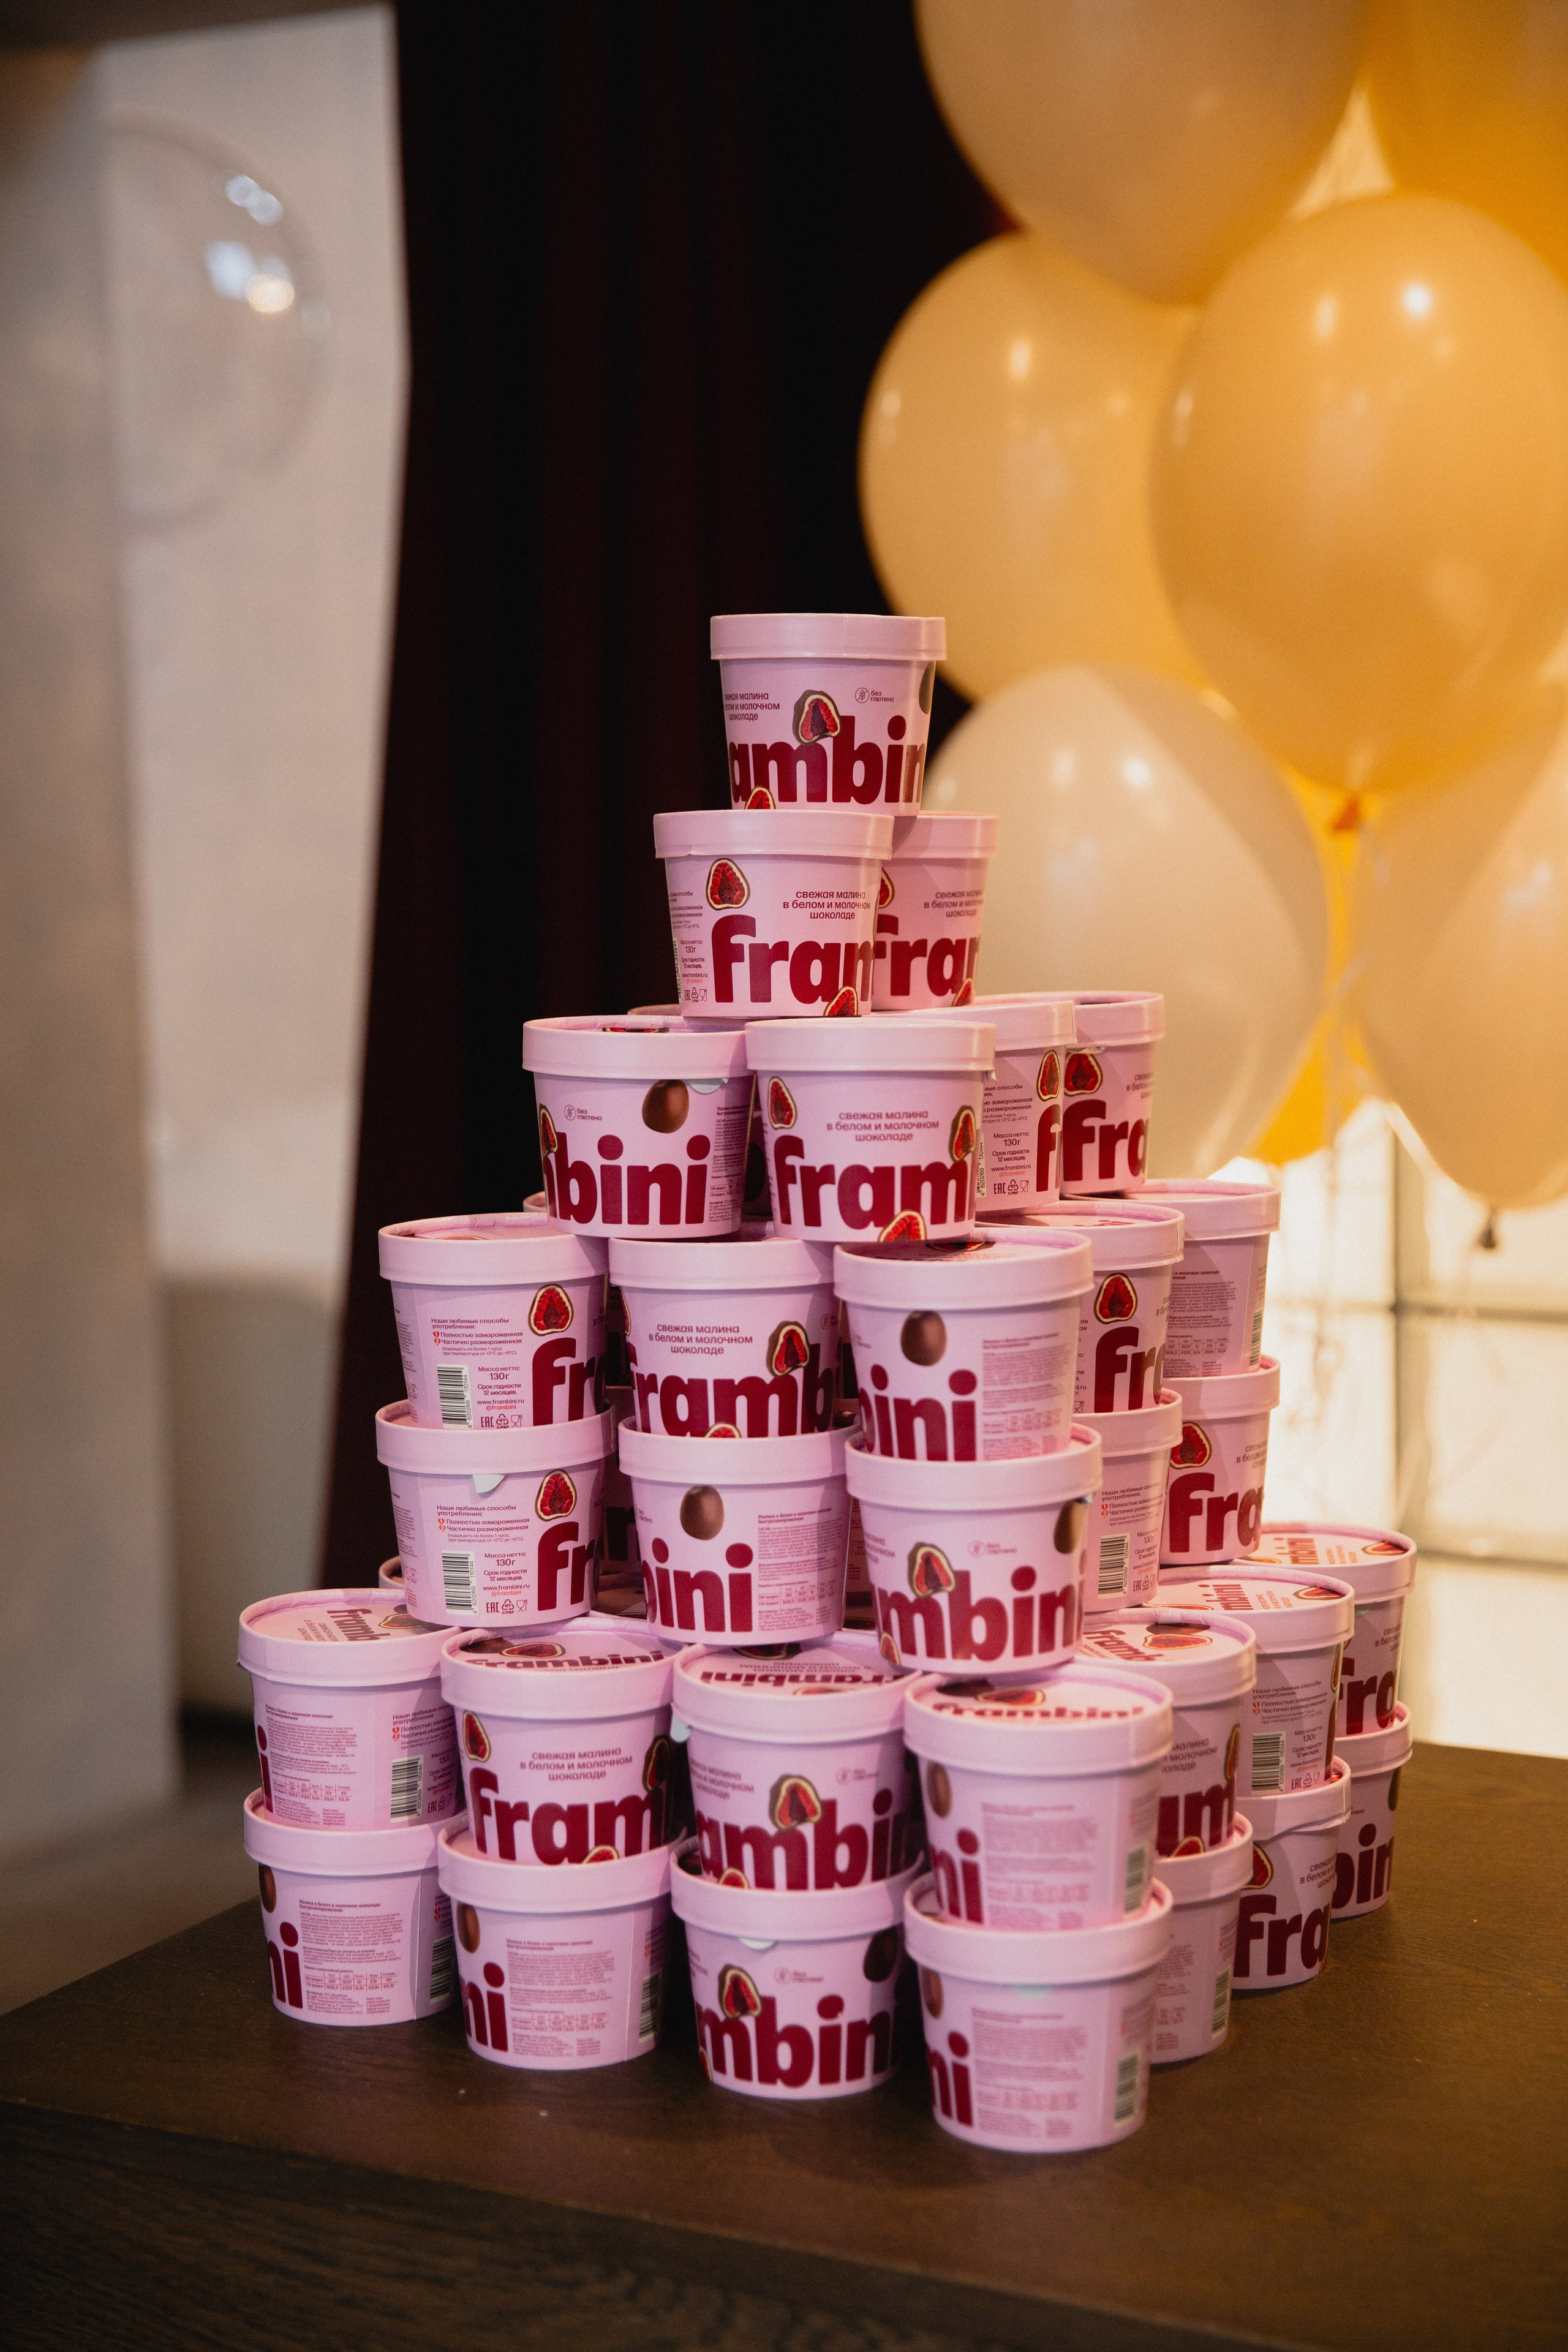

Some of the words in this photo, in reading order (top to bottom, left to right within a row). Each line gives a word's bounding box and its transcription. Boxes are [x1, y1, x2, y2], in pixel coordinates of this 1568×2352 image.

[792, 900, 825, 909] белом
[839, 1110, 882, 1120] свежая
[886, 1110, 928, 1120] малина
[836, 1121, 872, 1131] белом
[884, 1121, 939, 1130] молочном
[856, 1133, 913, 1141] шоколаде
[657, 1324, 693, 1333] свежая
[696, 1325, 739, 1333] малина
[655, 1333, 684, 1343] белом
[695, 1335, 752, 1344] молочном
[671, 1346, 724, 1355] шоколаде
[1102, 1492, 1141, 1502] употребления:
[401, 1723, 431, 1732] Полностью
[401, 1730, 428, 1739] Частично
[532, 1750, 575, 1760] свежая
[578, 1748, 621, 1758] малина
[529, 1760, 564, 1770] белом
[577, 1755, 632, 1770] молочном
[548, 1770, 606, 1781] шоколаде
